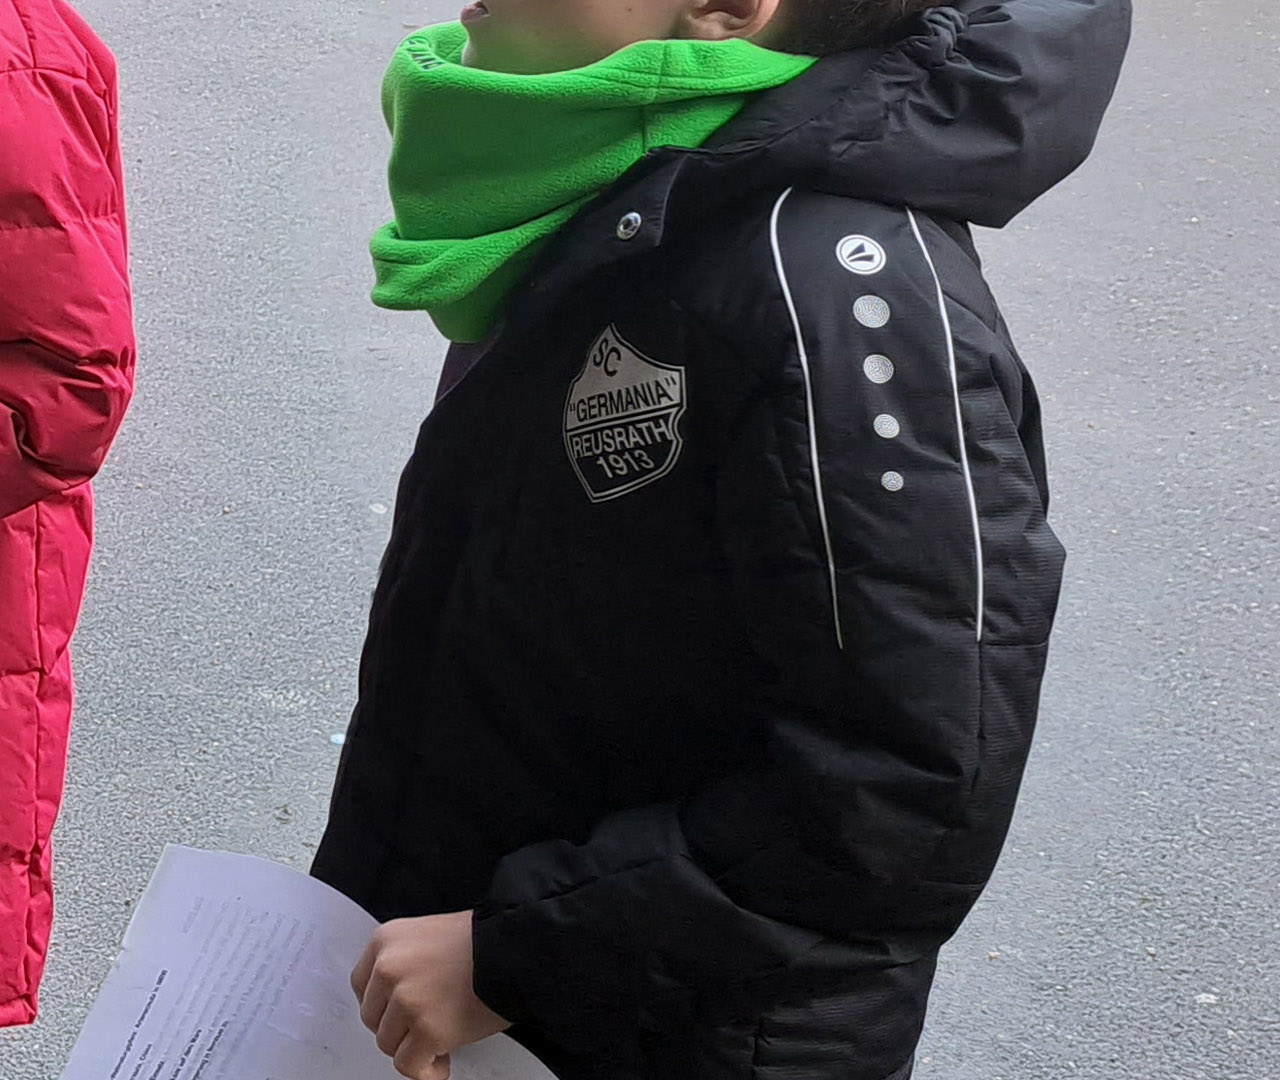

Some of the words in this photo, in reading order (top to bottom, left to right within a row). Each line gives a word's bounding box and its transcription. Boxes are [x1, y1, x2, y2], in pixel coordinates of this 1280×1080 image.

[593, 338, 621, 377] SC
[572, 418, 674, 460] REUSRATH
[596, 449, 655, 479] 1913
